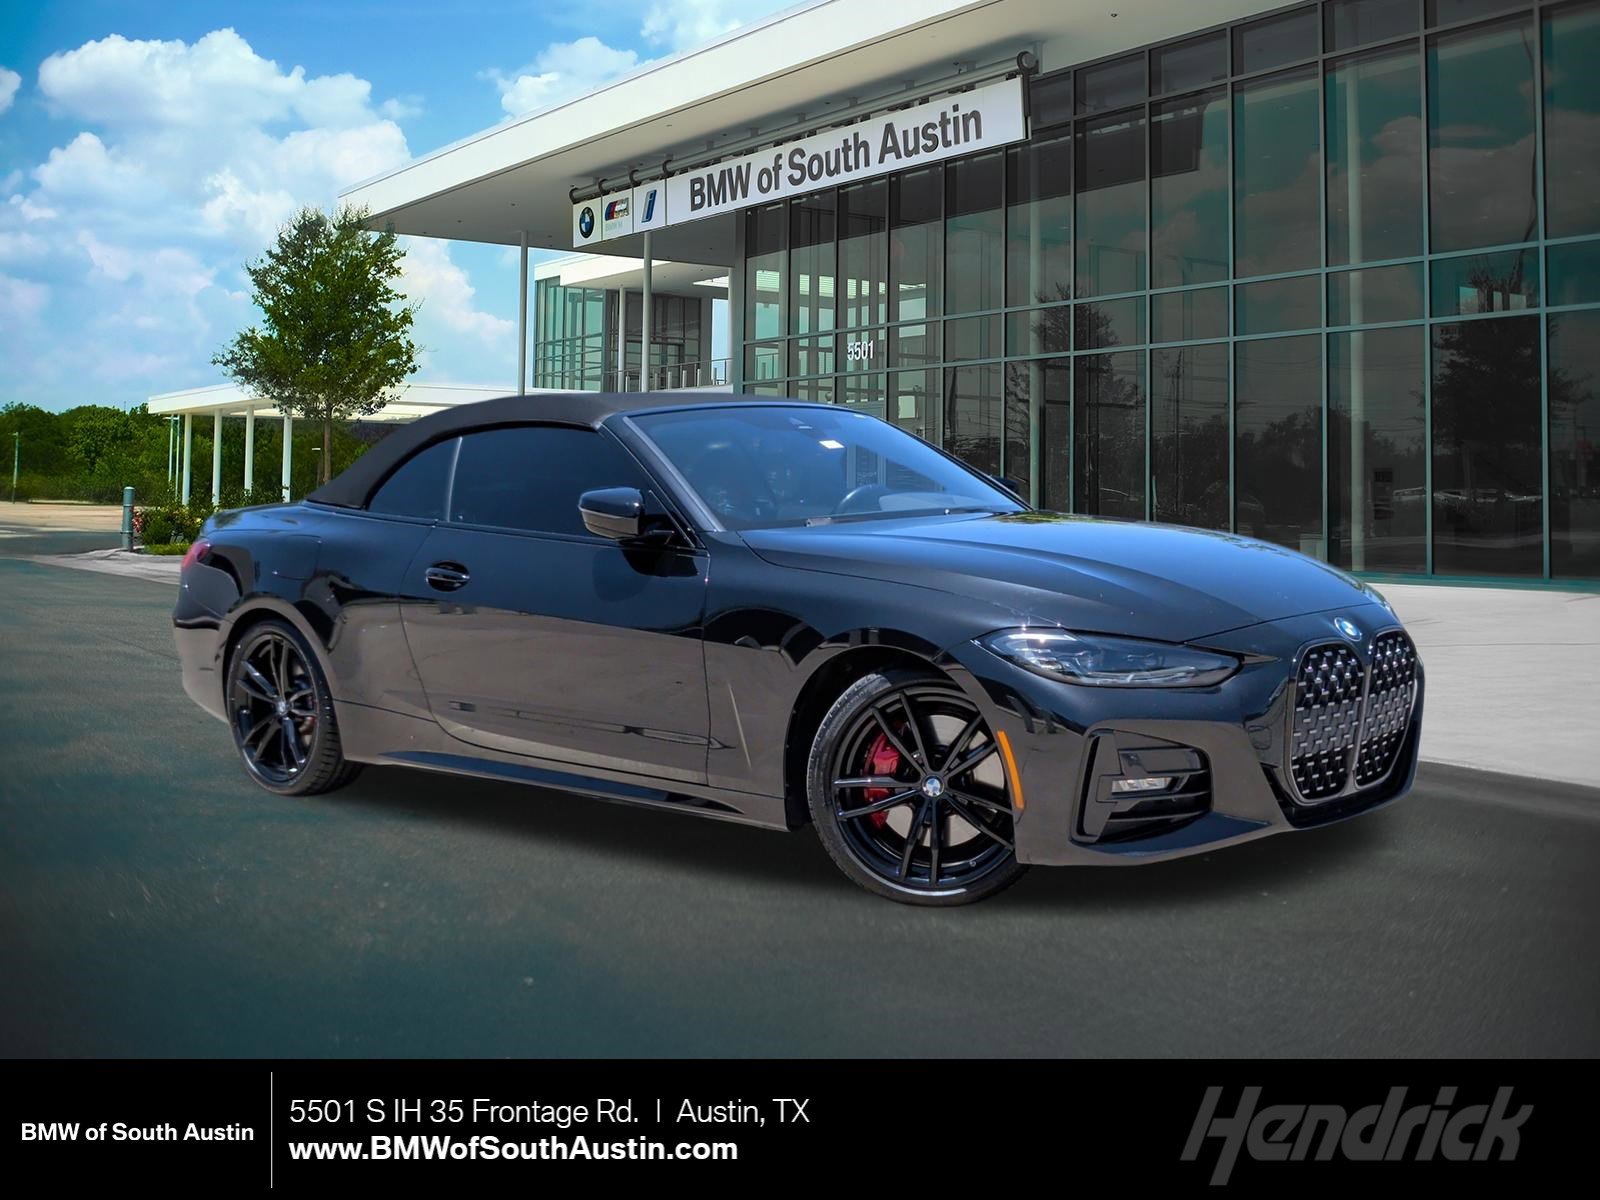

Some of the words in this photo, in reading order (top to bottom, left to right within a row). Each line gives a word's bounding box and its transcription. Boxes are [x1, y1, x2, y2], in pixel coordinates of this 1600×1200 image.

[689, 162, 751, 212] BMW
[757, 153, 783, 195] of
[787, 132, 870, 187] South
[878, 104, 982, 165] Austin
[847, 340, 874, 361] 5501
